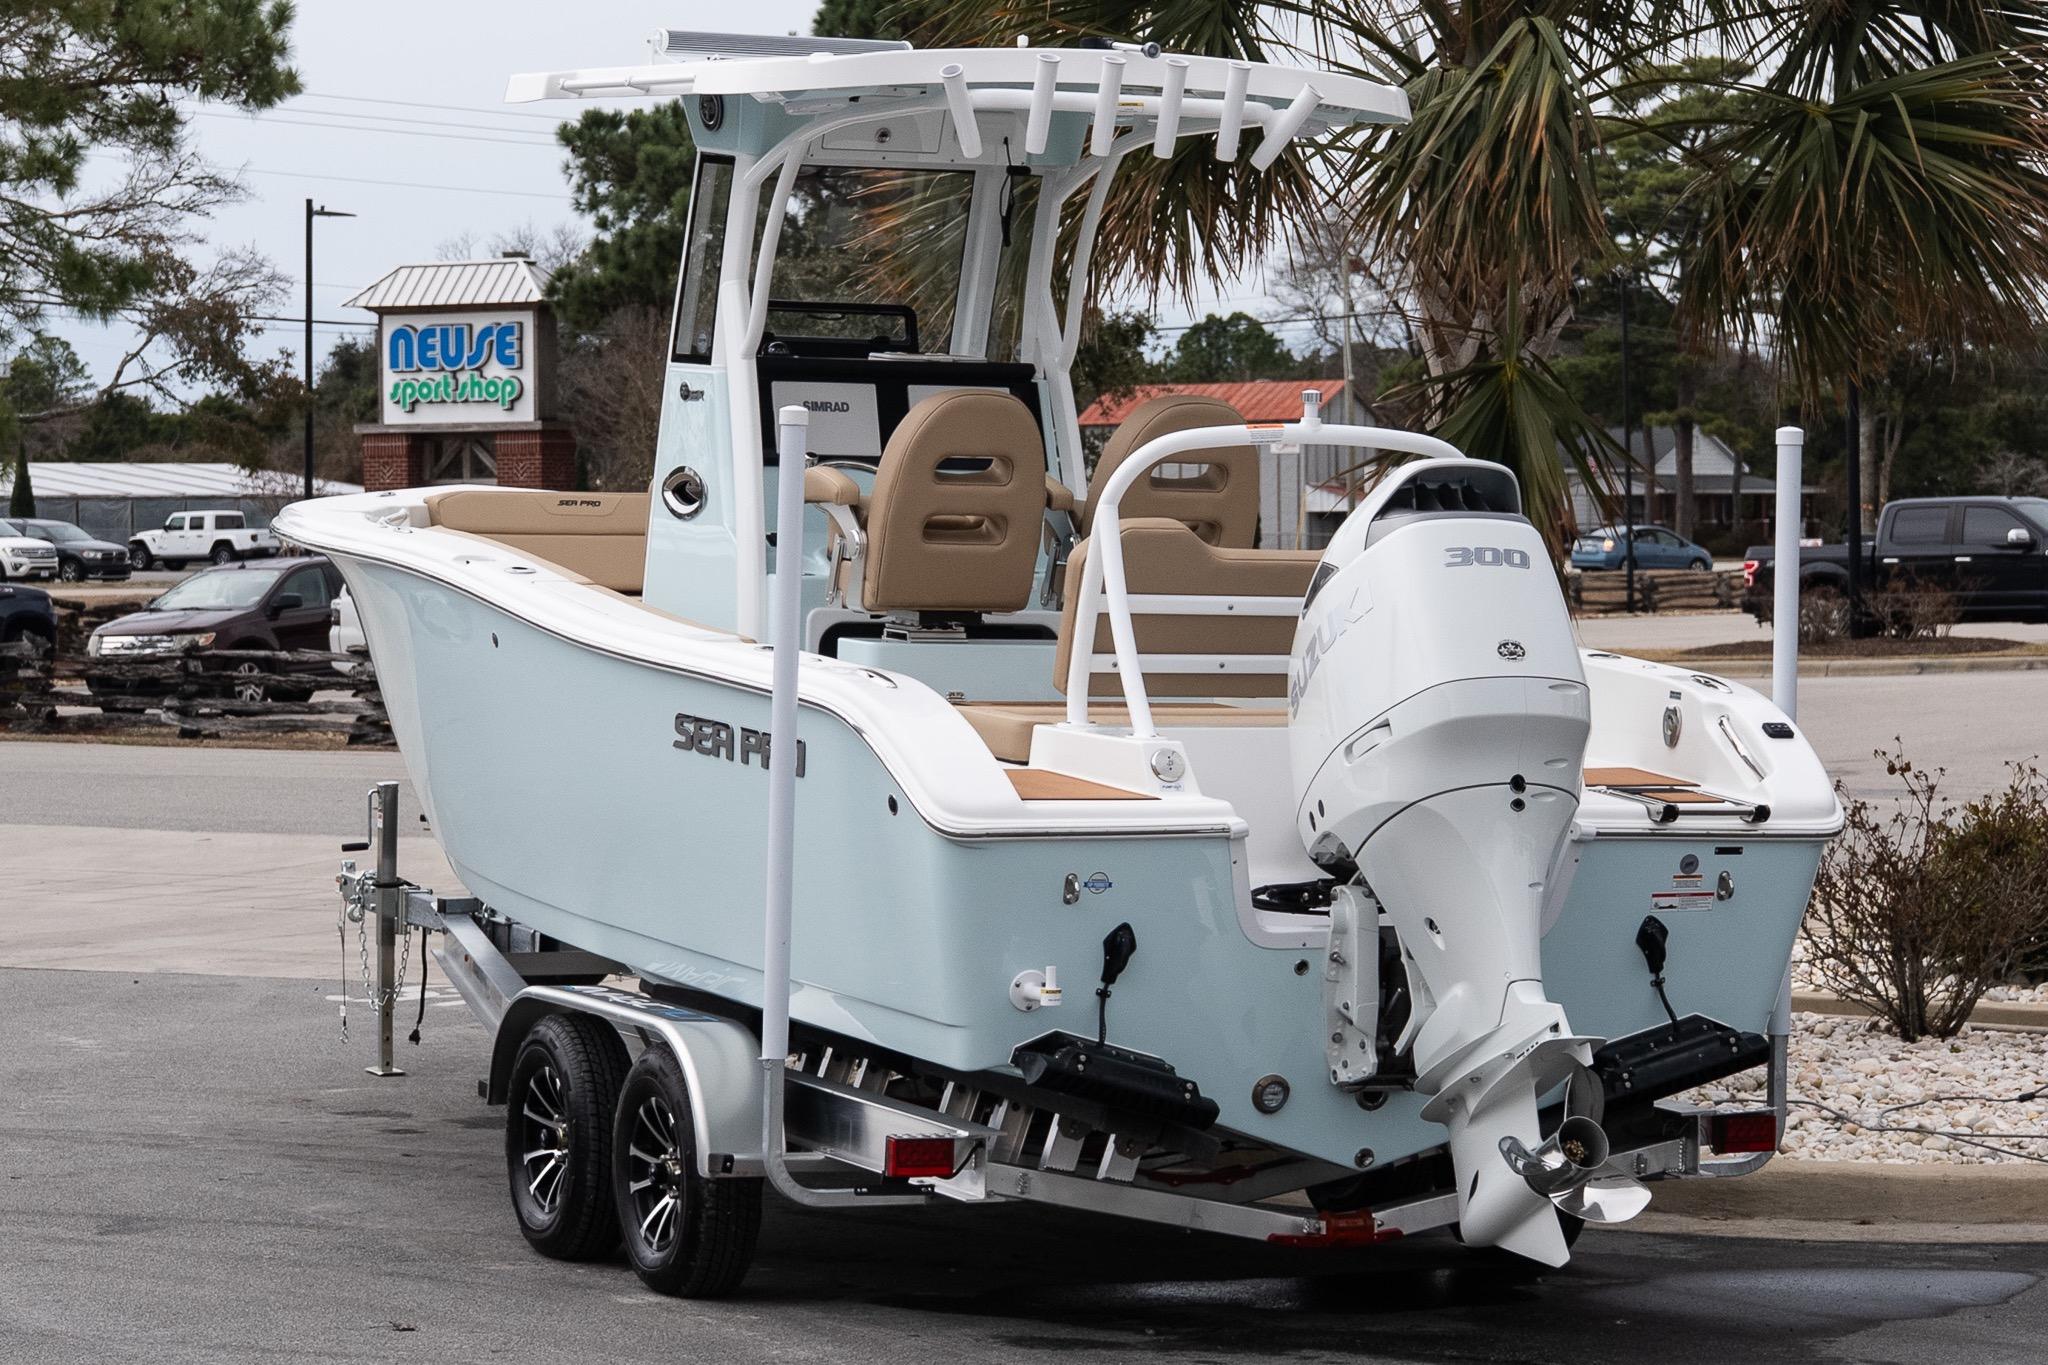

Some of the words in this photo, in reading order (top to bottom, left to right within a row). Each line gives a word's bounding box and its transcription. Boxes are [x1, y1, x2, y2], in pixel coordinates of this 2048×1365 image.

[389, 323, 519, 371] NEUSE
[390, 373, 453, 412] sport
[456, 371, 518, 409] shop
[803, 401, 849, 412] SIMRAD
[558, 499, 578, 507] SEA
[579, 500, 602, 508] PRO
[1444, 547, 1531, 569] 300
[673, 712, 735, 762] SEA
